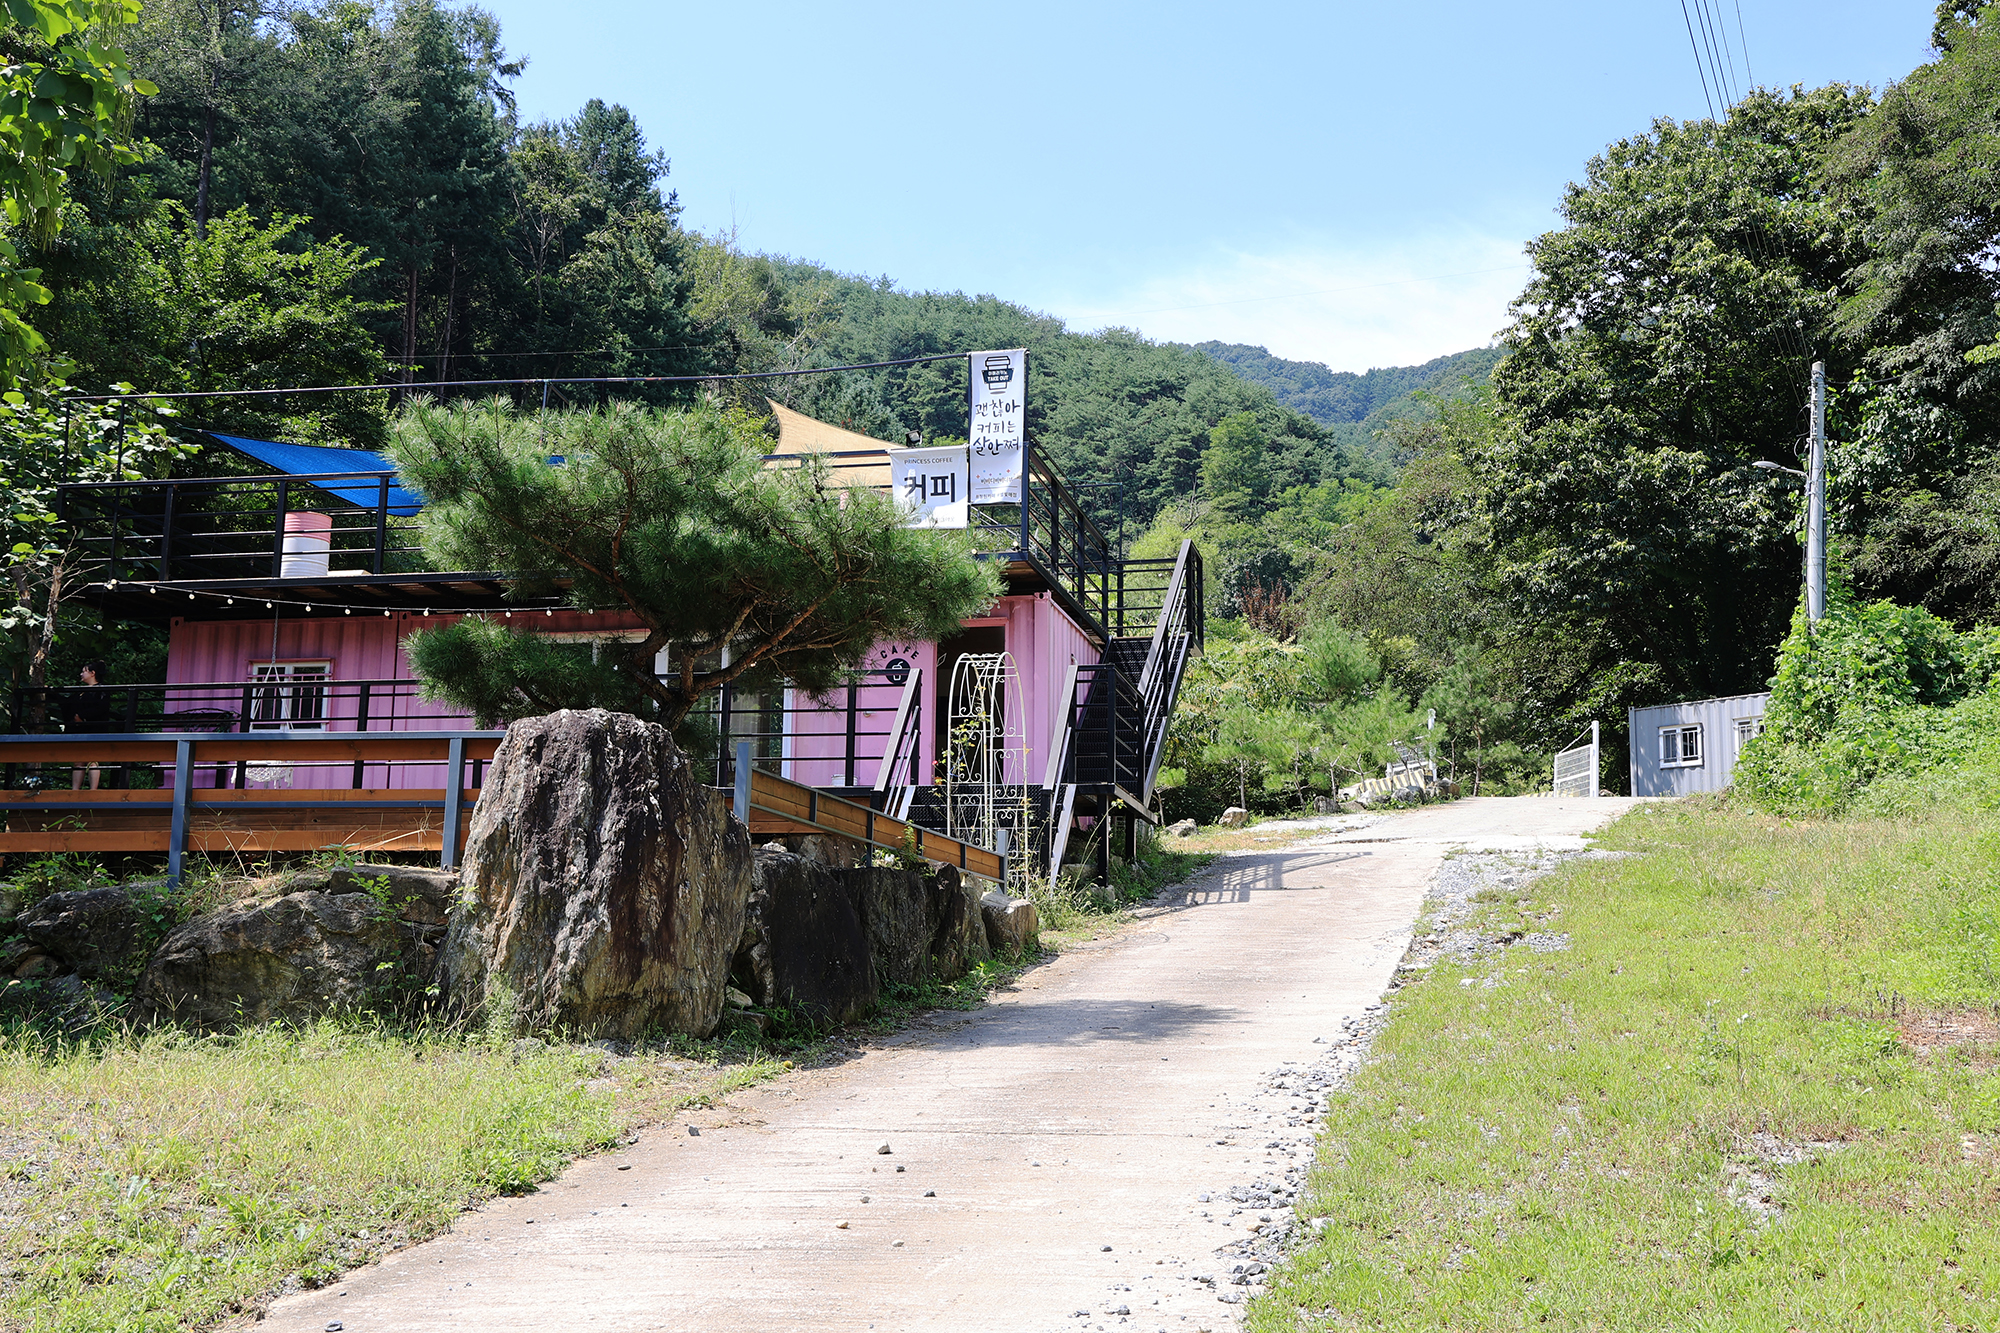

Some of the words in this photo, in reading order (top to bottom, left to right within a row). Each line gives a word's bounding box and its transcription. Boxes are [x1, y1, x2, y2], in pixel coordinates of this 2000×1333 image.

[975, 399, 1020, 417] 괜찮아
[977, 420, 1016, 433] 커피는
[904, 472, 955, 504] 커피
[880, 645, 919, 660] CAFE
